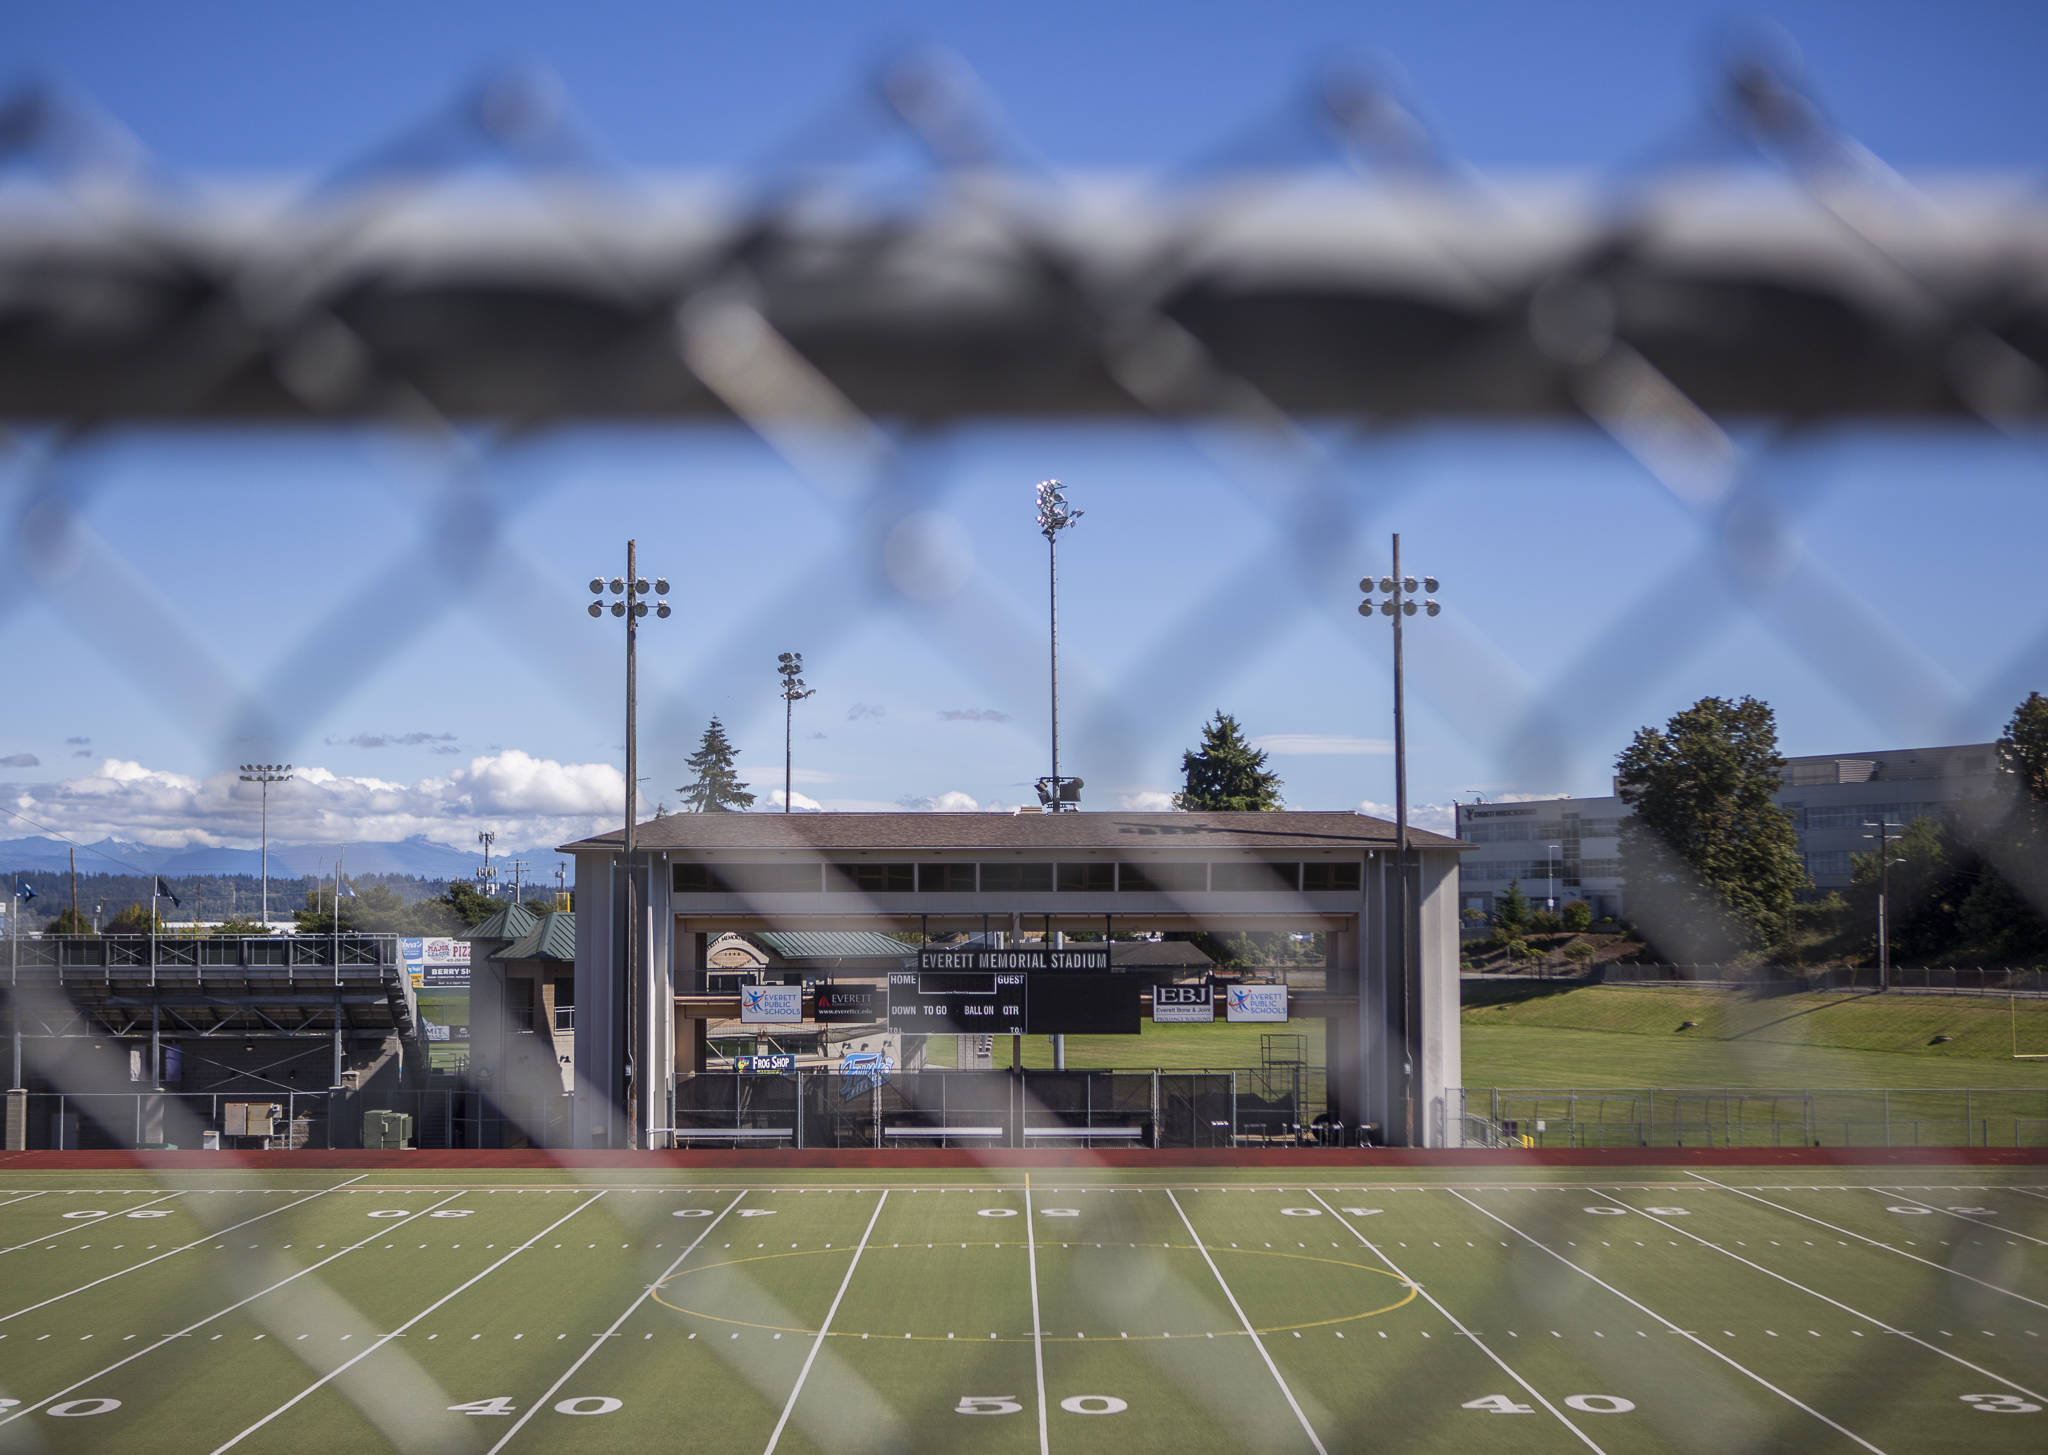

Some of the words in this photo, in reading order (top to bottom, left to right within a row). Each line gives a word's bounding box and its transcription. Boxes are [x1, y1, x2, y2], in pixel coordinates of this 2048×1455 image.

[922, 953, 975, 968] EVERETT
[979, 953, 1046, 968] MEMORIAL
[1051, 953, 1107, 968] STADIUM
[890, 975, 917, 984] HOME
[997, 975, 1025, 984] GUEST
[832, 994, 872, 1003] EVERETT
[1159, 987, 1208, 1003] EBJ
[1250, 993, 1282, 1001] EVERETT
[891, 1006, 917, 1016] DOWN
[923, 1006, 934, 1016] TO
[936, 1006, 947, 1016] GO
[964, 1006, 982, 1016] BALL
[983, 1006, 994, 1016] ON
[1003, 1006, 1019, 1016] QTR
[1959, 1393, 2043, 1413] 3
